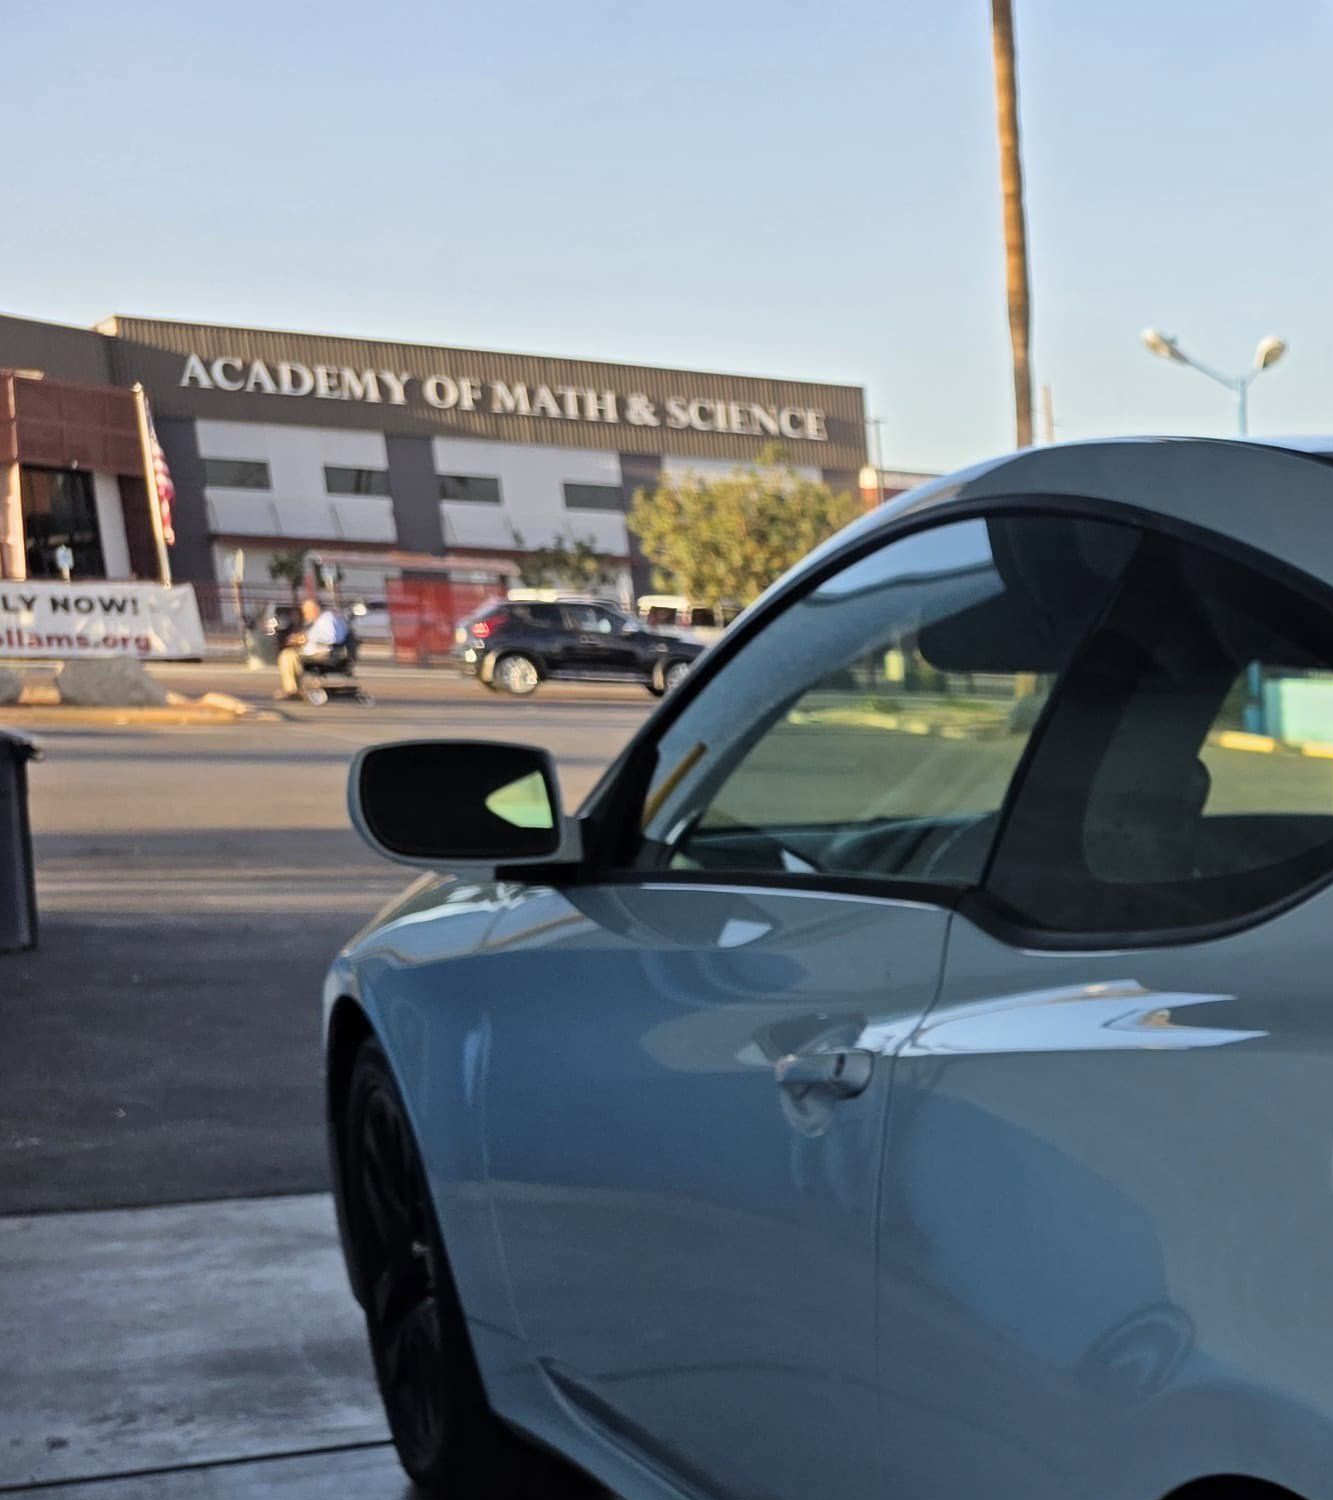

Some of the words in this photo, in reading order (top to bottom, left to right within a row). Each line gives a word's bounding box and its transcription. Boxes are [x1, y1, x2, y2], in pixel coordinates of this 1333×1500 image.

[179, 352, 410, 405] ACADEMY
[421, 373, 482, 411] OF
[488, 380, 619, 423] MATH
[624, 391, 661, 428] &
[666, 396, 829, 441] SCIENCE
[50, 594, 140, 616] NOW!
